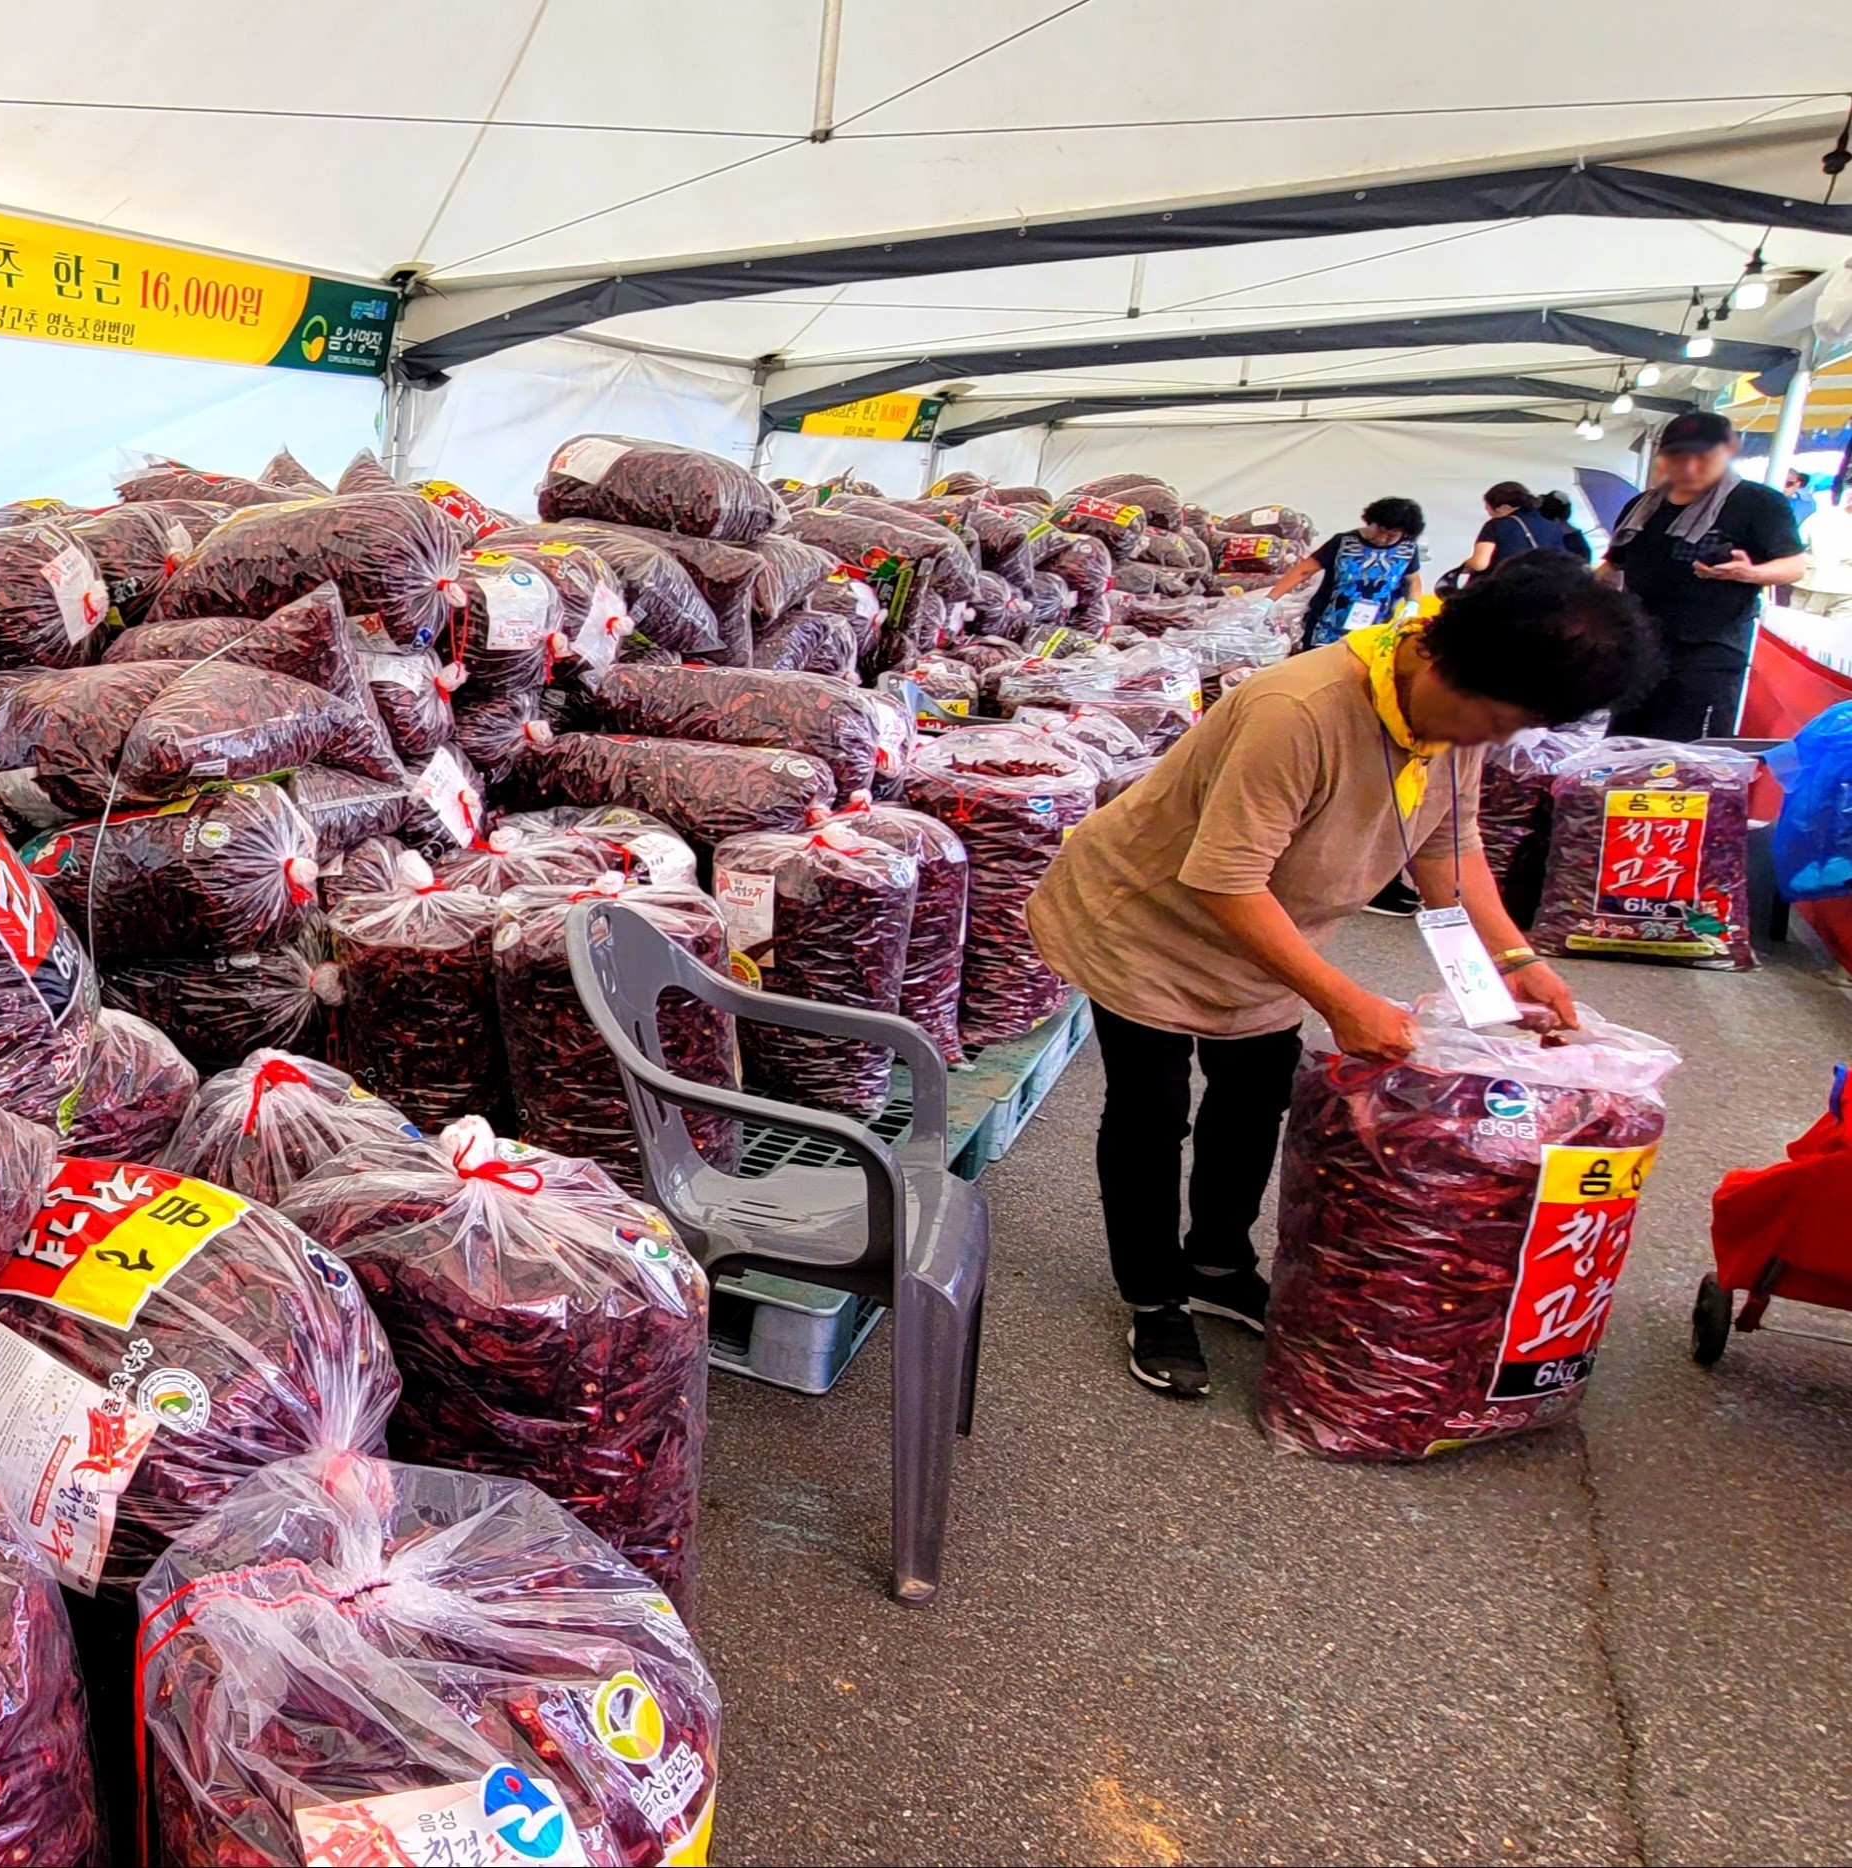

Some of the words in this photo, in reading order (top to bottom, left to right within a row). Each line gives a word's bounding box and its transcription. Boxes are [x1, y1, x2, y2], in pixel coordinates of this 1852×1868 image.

[138, 267, 265, 327] 16,000원
[46, 311, 136, 346] 영농조합법인
[328, 327, 383, 357] 음성명작
[1628, 793, 1687, 812] 음성
[1609, 819, 1690, 856] 청결
[1606, 858, 1687, 900] 고추
[1623, 897, 1668, 917] 6kg
[1534, 1359, 1578, 1388] 6kg
[417, 1810, 458, 1833] 음성
